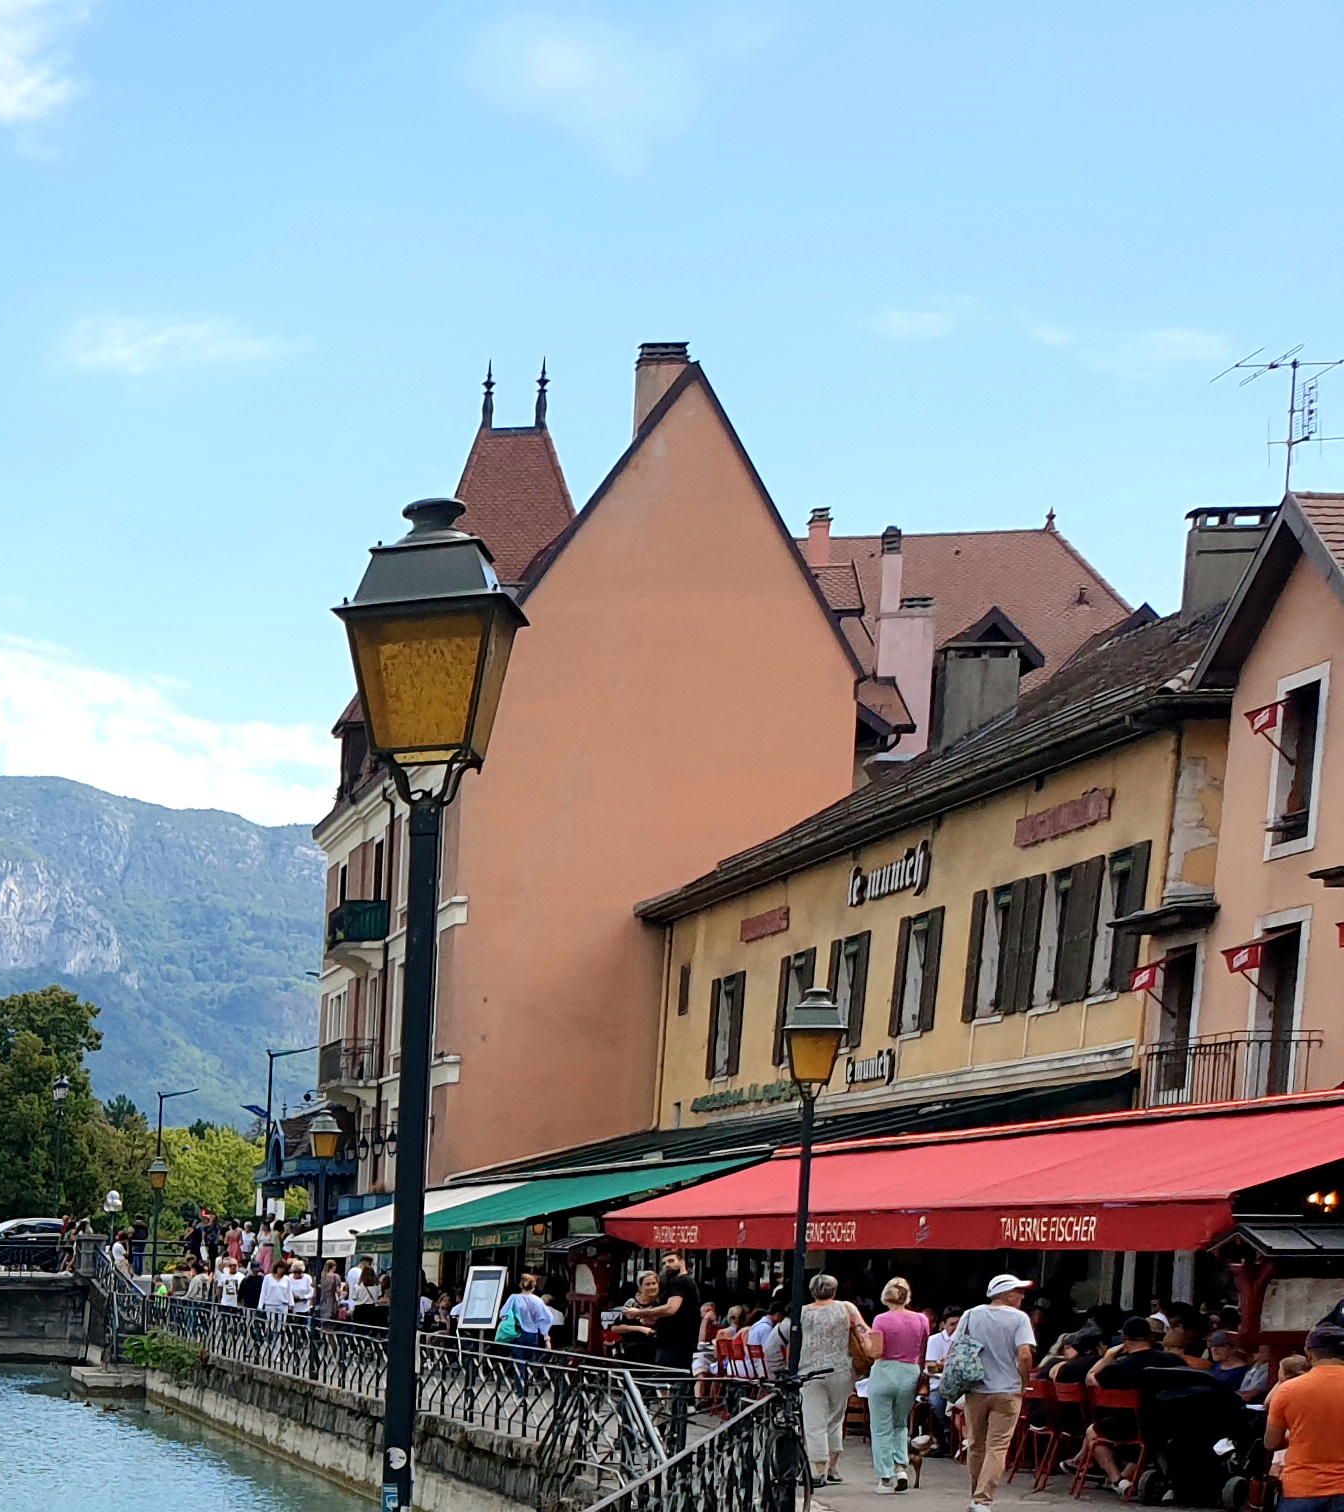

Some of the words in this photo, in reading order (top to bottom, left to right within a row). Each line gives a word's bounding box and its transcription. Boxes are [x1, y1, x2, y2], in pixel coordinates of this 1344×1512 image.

[826, 1221, 857, 1242] FISCHER
[1000, 1217, 1048, 1242] TAVERNE
[1049, 1216, 1097, 1242] FISCHER
